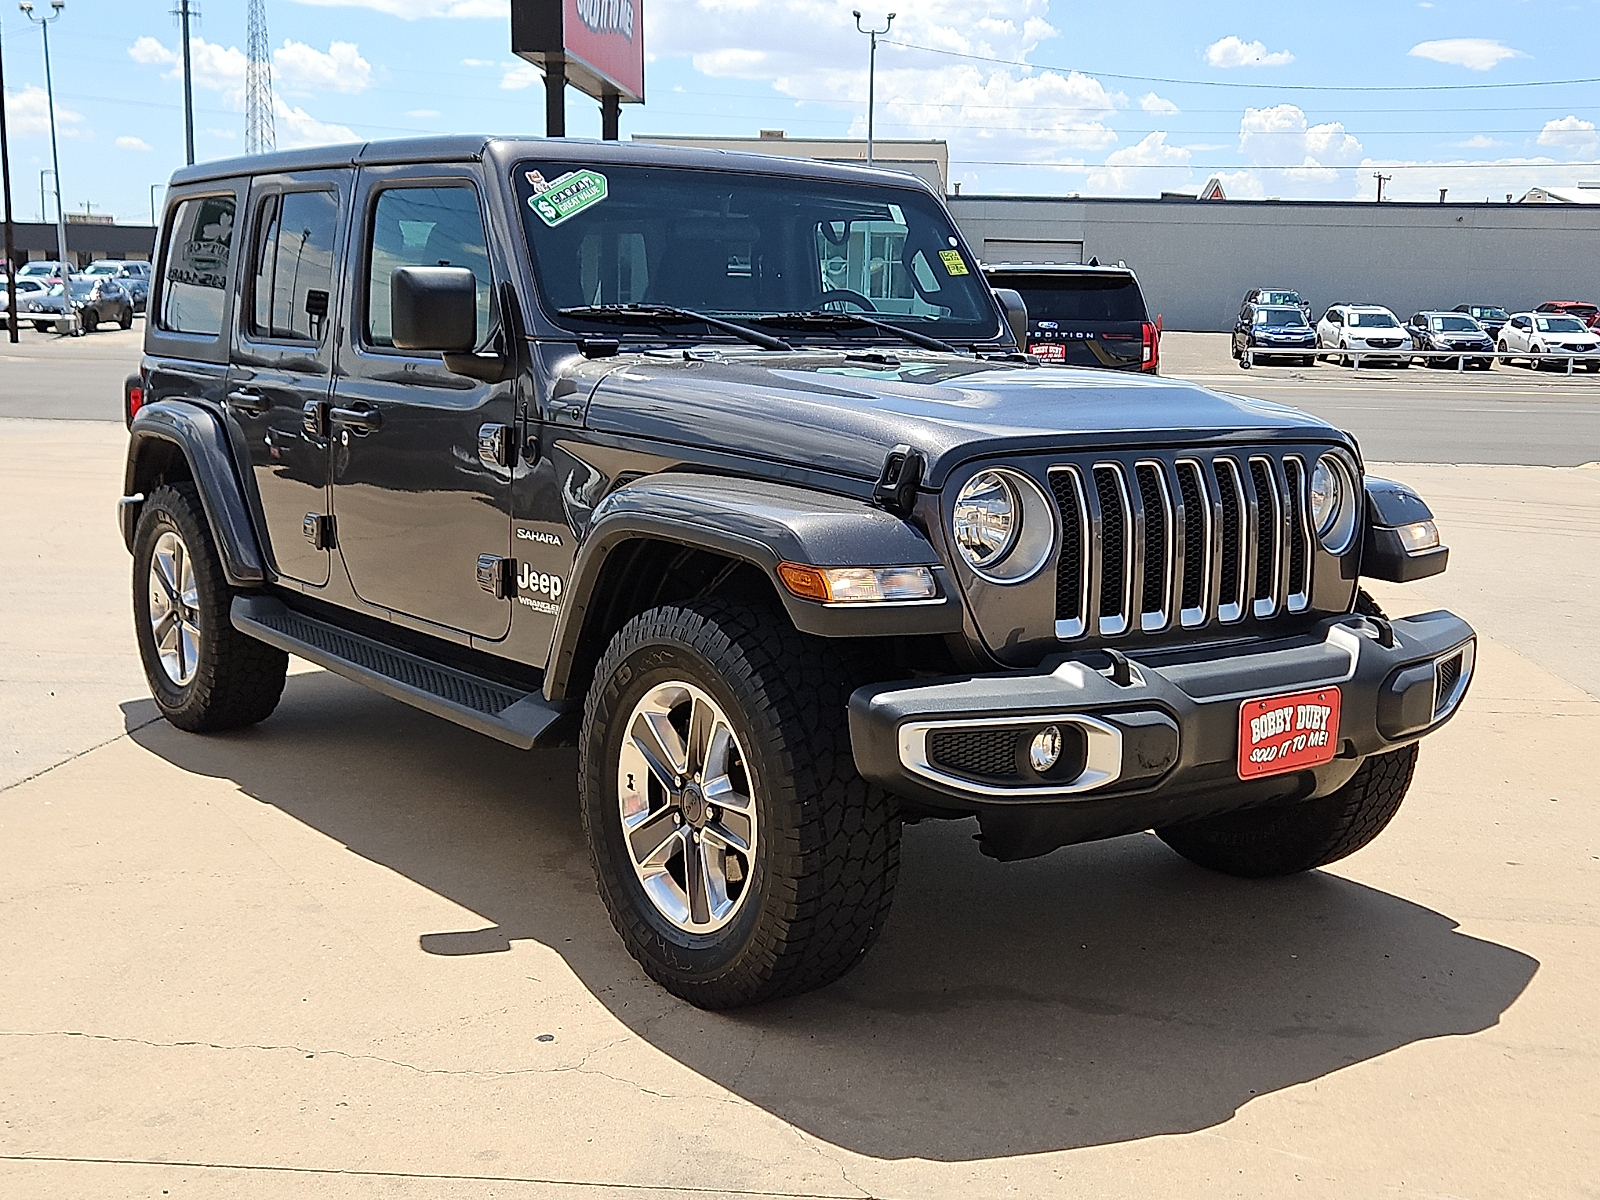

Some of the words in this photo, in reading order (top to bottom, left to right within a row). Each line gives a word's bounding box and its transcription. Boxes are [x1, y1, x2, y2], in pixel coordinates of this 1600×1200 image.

[550, 176, 595, 204] CARFAX
[559, 196, 580, 213] GREAT
[578, 185, 601, 201] VALUE
[517, 528, 562, 546] SAHARA
[517, 563, 562, 600] Jeep
[1250, 706, 1294, 744] BOBBY
[1296, 704, 1331, 730] DUBY
[1249, 746, 1277, 762] SOLD
[1278, 740, 1292, 758] IT
[1292, 734, 1307, 752] TO
[1307, 730, 1329, 747] ME!
